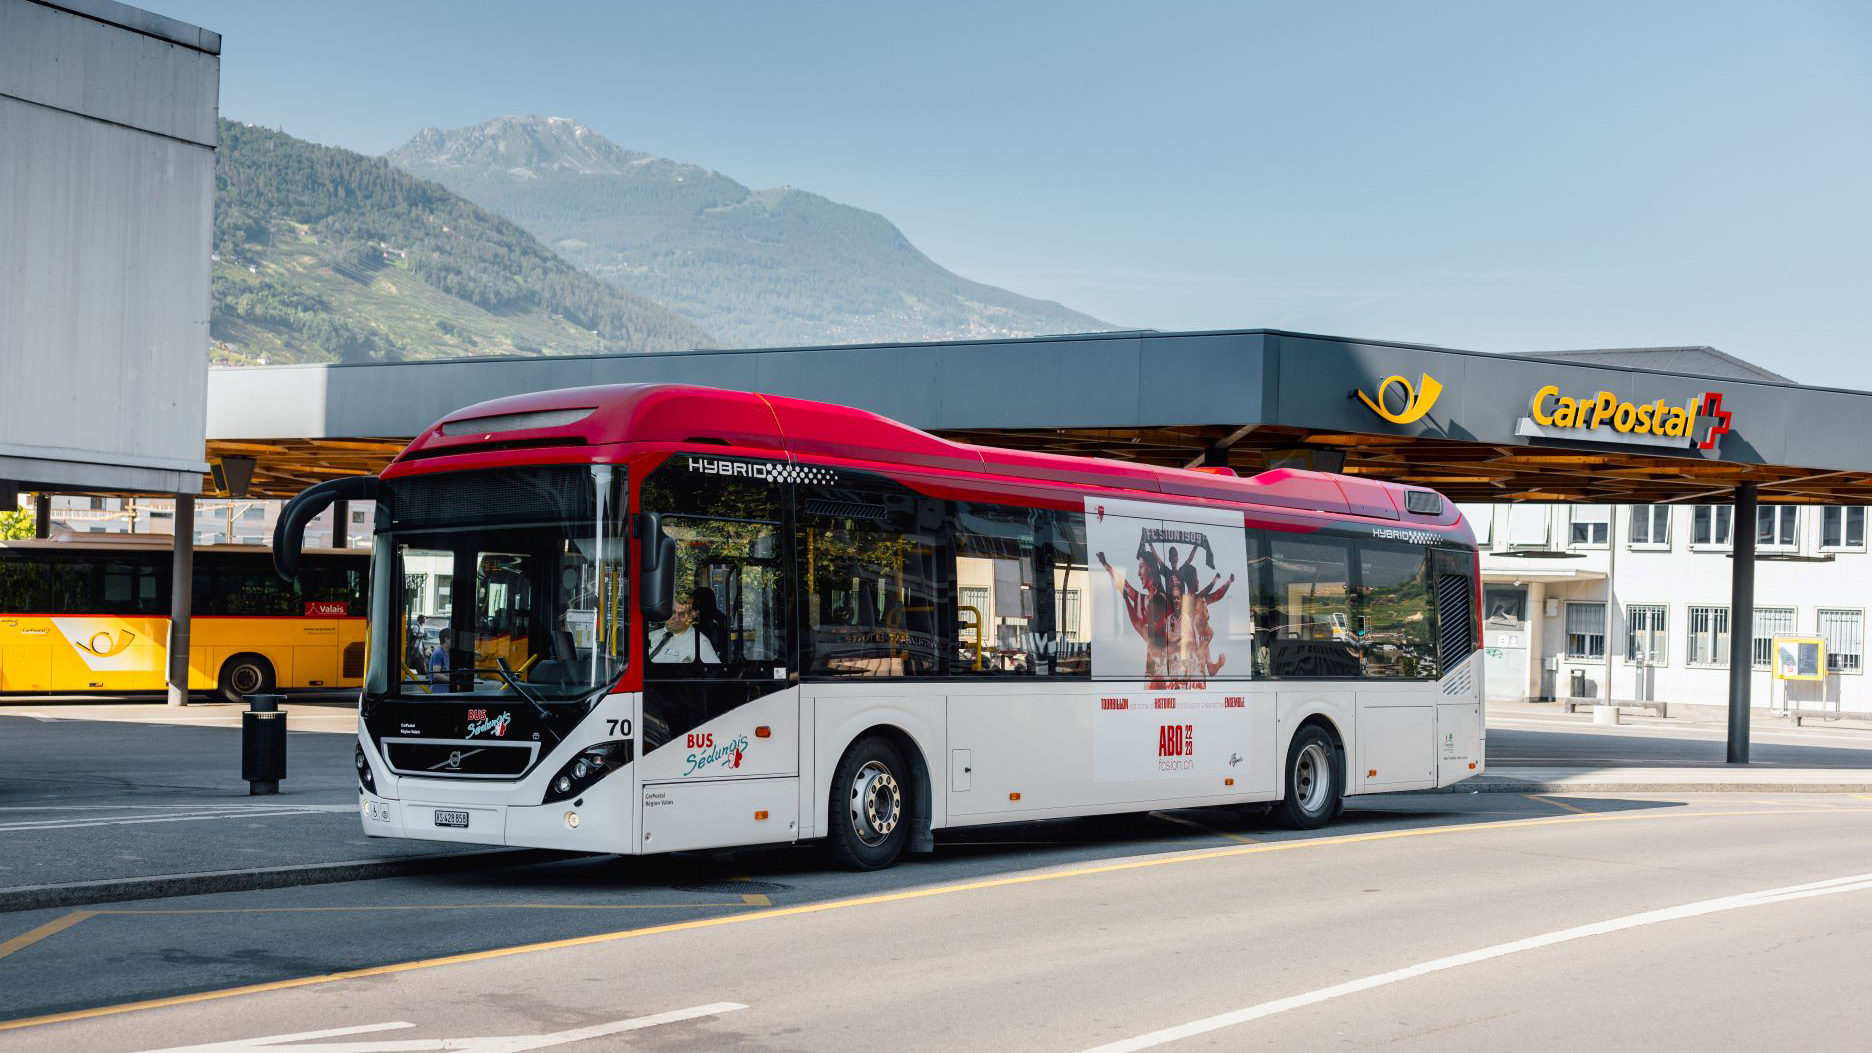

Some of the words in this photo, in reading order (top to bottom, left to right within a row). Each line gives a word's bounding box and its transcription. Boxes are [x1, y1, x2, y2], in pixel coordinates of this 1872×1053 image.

[1532, 385, 1698, 437] CarPostal
[688, 457, 767, 479] HYBRID
[1146, 529, 1158, 540] FC
[1160, 529, 1180, 541] SION
[1181, 530, 1202, 545] 1909
[1372, 528, 1409, 541] HYBRID
[320, 604, 344, 613] Valais
[467, 709, 487, 720] BUS
[606, 719, 632, 736] 70
[687, 733, 714, 749] BUS
[1158, 725, 1183, 757] ABO
[1185, 725, 1193, 740] 22
[1185, 741, 1193, 756] 23
[683, 734, 749, 776] Sédunois
[1158, 758, 1194, 772] fcsion.ch
